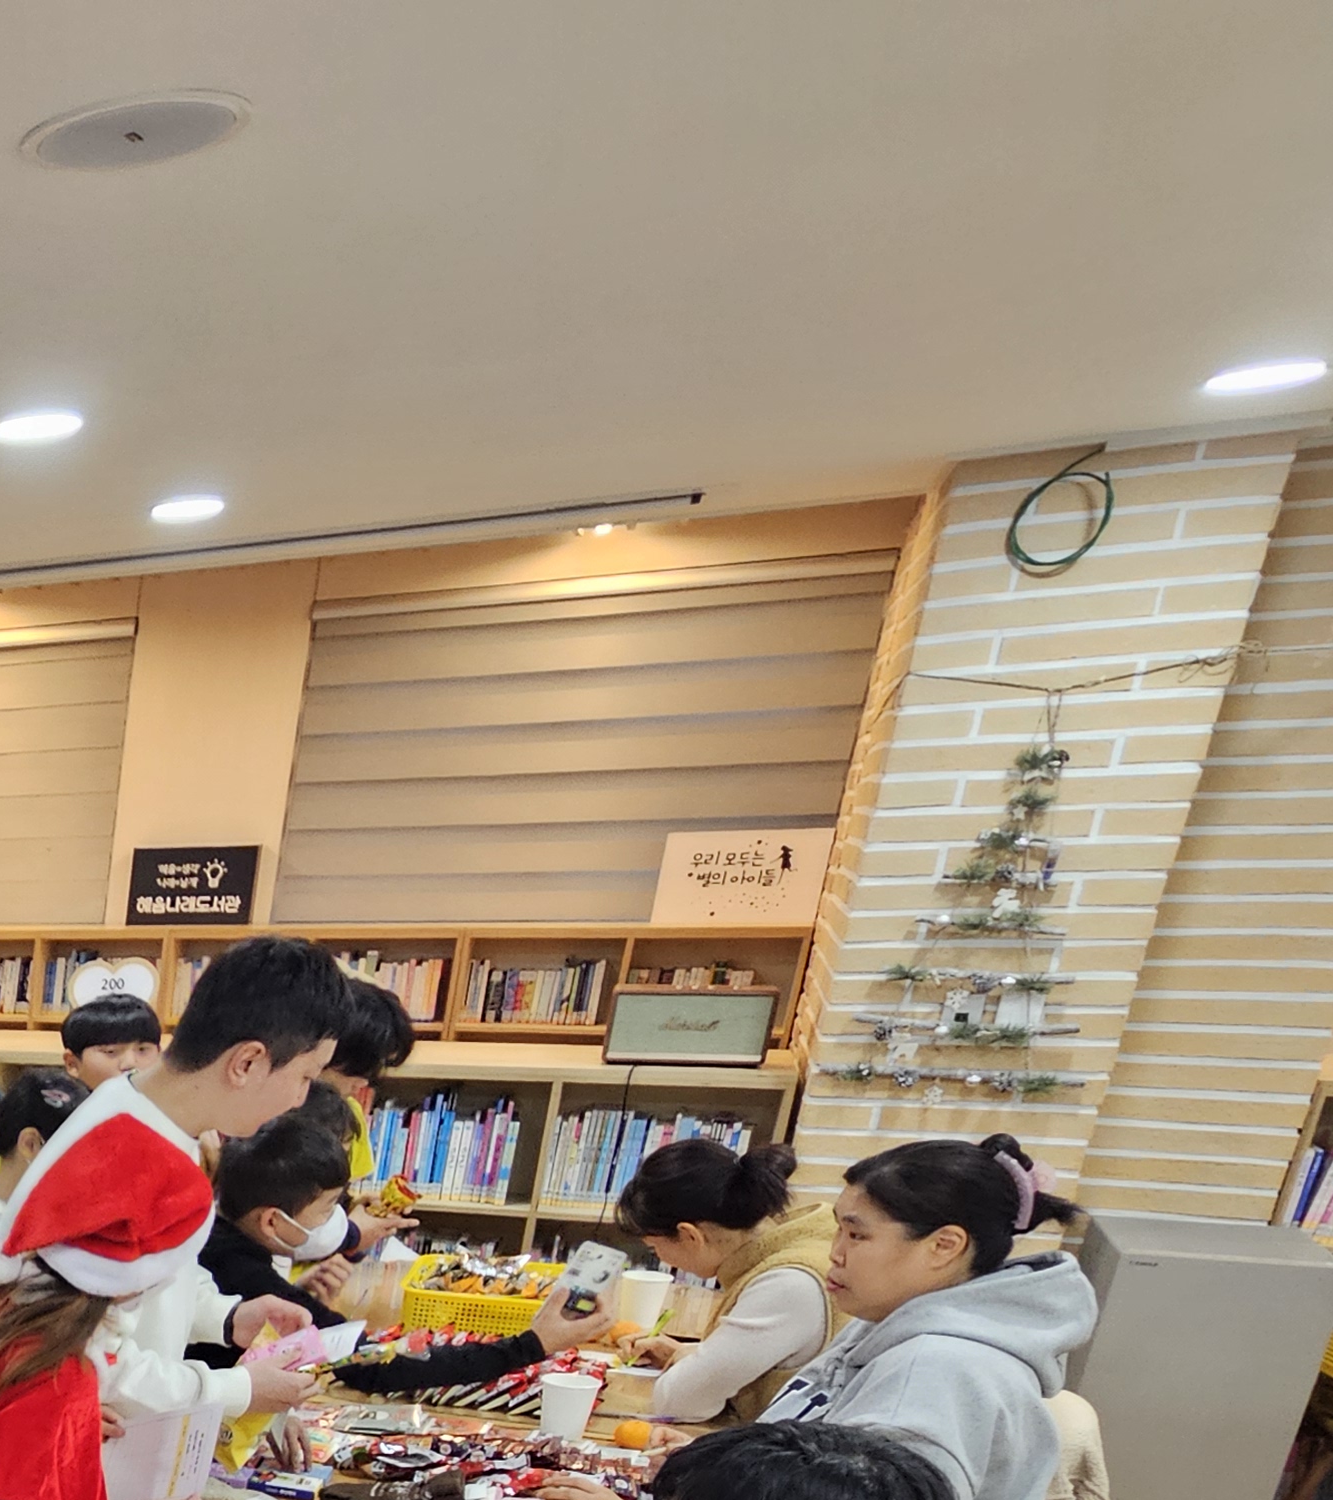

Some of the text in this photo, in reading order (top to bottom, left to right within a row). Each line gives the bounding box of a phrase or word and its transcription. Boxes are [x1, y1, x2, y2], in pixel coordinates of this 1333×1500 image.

[690, 850, 765, 868] 우리 모두는
[696, 869, 776, 888] 별의 아이들
[101, 977, 125, 991] 200
